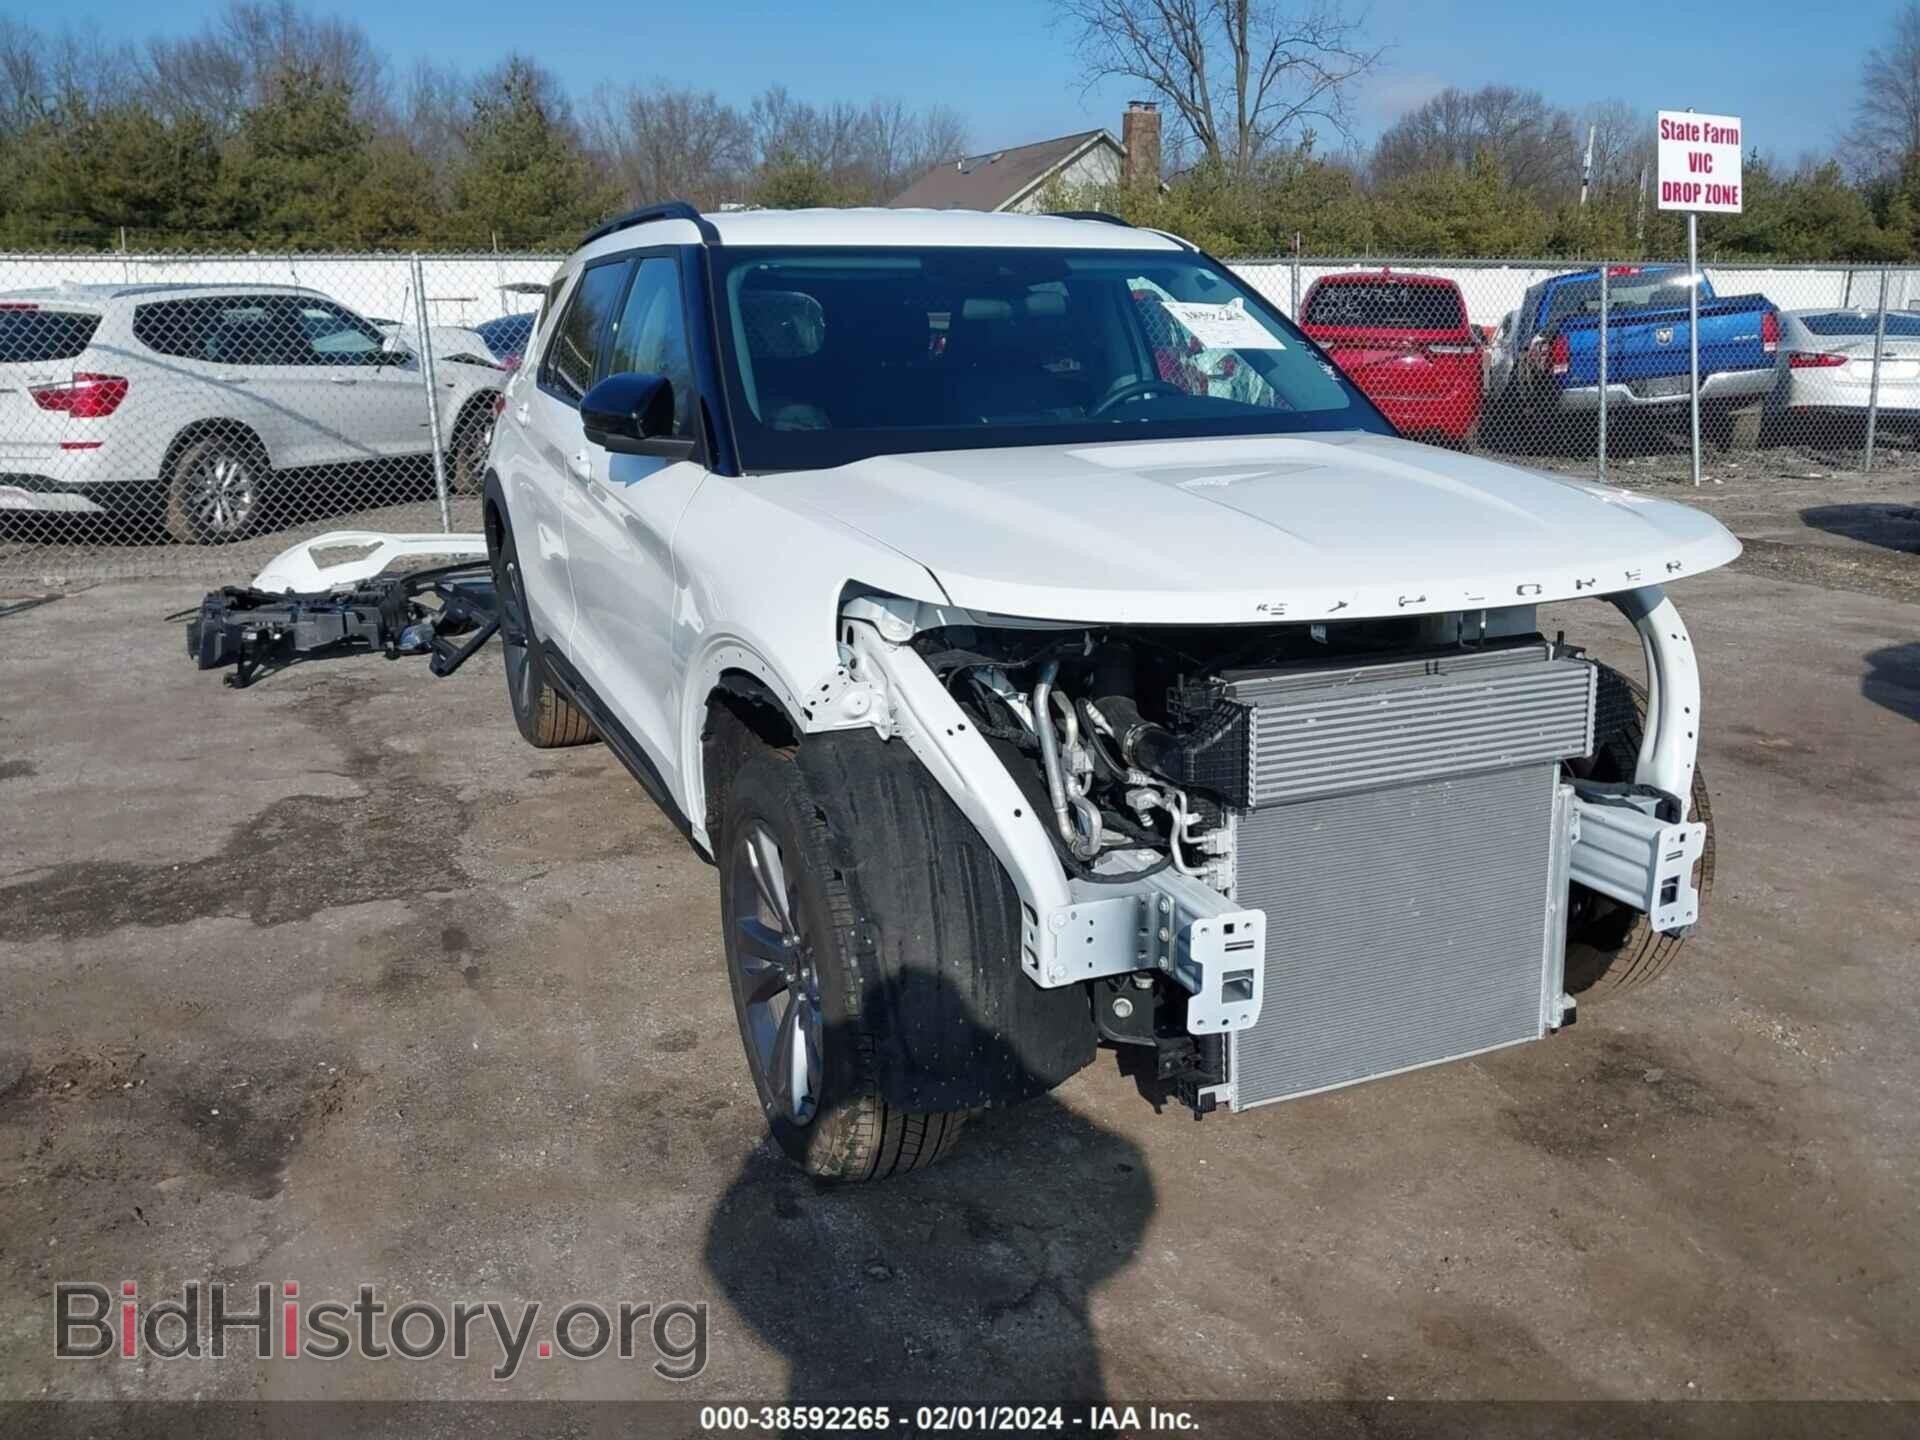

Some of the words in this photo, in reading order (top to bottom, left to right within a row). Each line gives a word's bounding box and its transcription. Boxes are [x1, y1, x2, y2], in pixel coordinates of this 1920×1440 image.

[1660, 118, 1700, 142] State
[1703, 122, 1739, 145] Farm
[1688, 152, 1713, 174] VIC
[1662, 181, 1701, 203] DROP
[1704, 184, 1739, 205] ZONE
